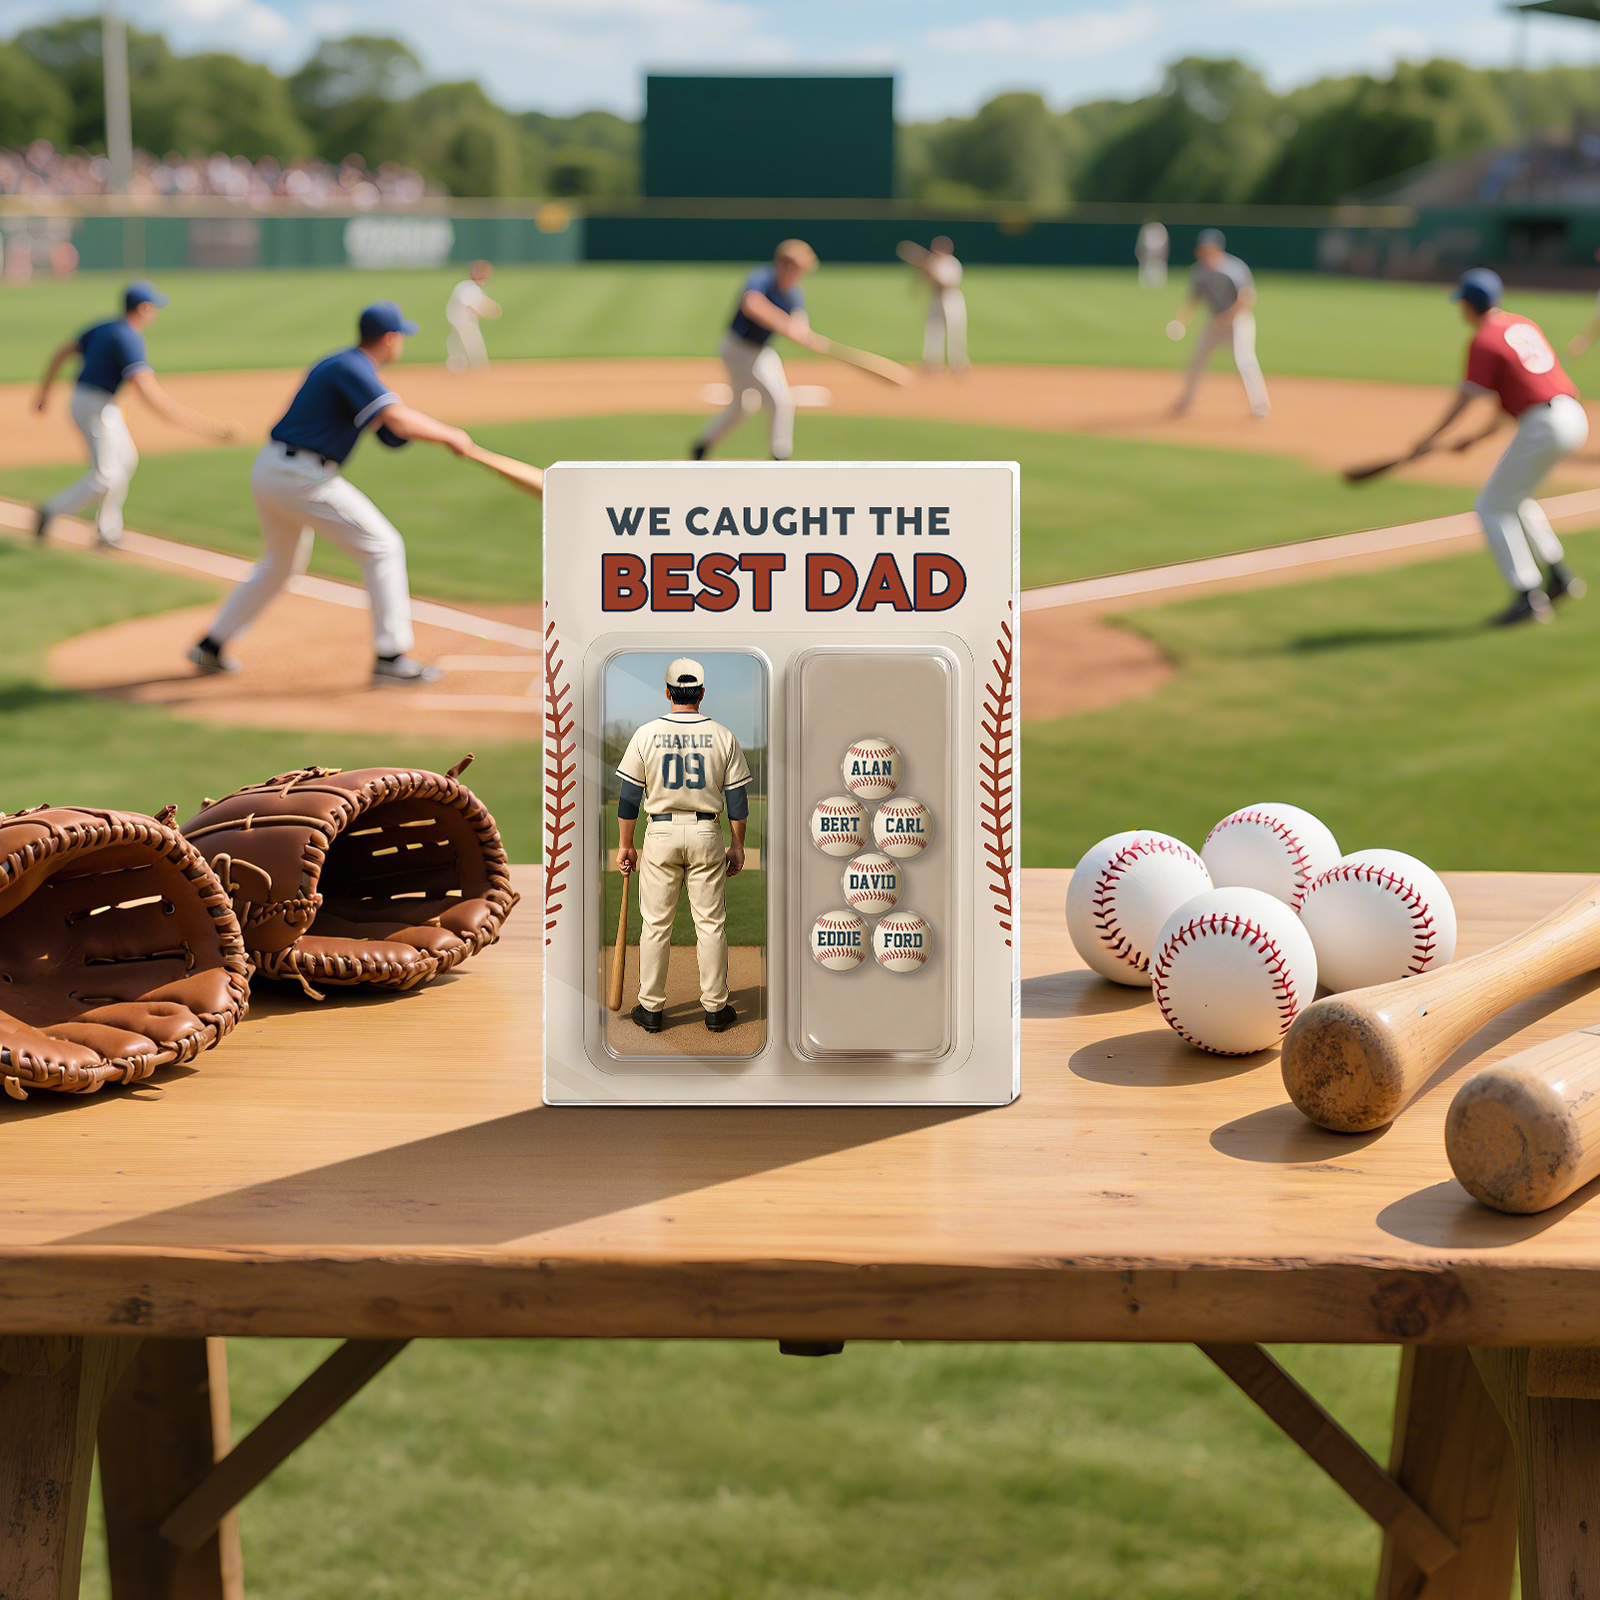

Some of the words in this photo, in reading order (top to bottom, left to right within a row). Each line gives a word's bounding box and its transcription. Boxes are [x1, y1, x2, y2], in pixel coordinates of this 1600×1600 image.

[605, 506, 671, 536] WE
[685, 506, 855, 536] CAUGHT
[869, 506, 951, 536] THE
[601, 553, 786, 612] BEST
[805, 553, 967, 612] DAD
[653, 733, 713, 749] CHARLIE
[661, 753, 706, 790] 09
[851, 760, 892, 776] ALAN
[820, 817, 860, 832] BERT
[885, 818, 925, 833] CARL
[849, 874, 896, 889] DAVID
[817, 931, 861, 946] EDDIE
[884, 933, 923, 948] FORD
